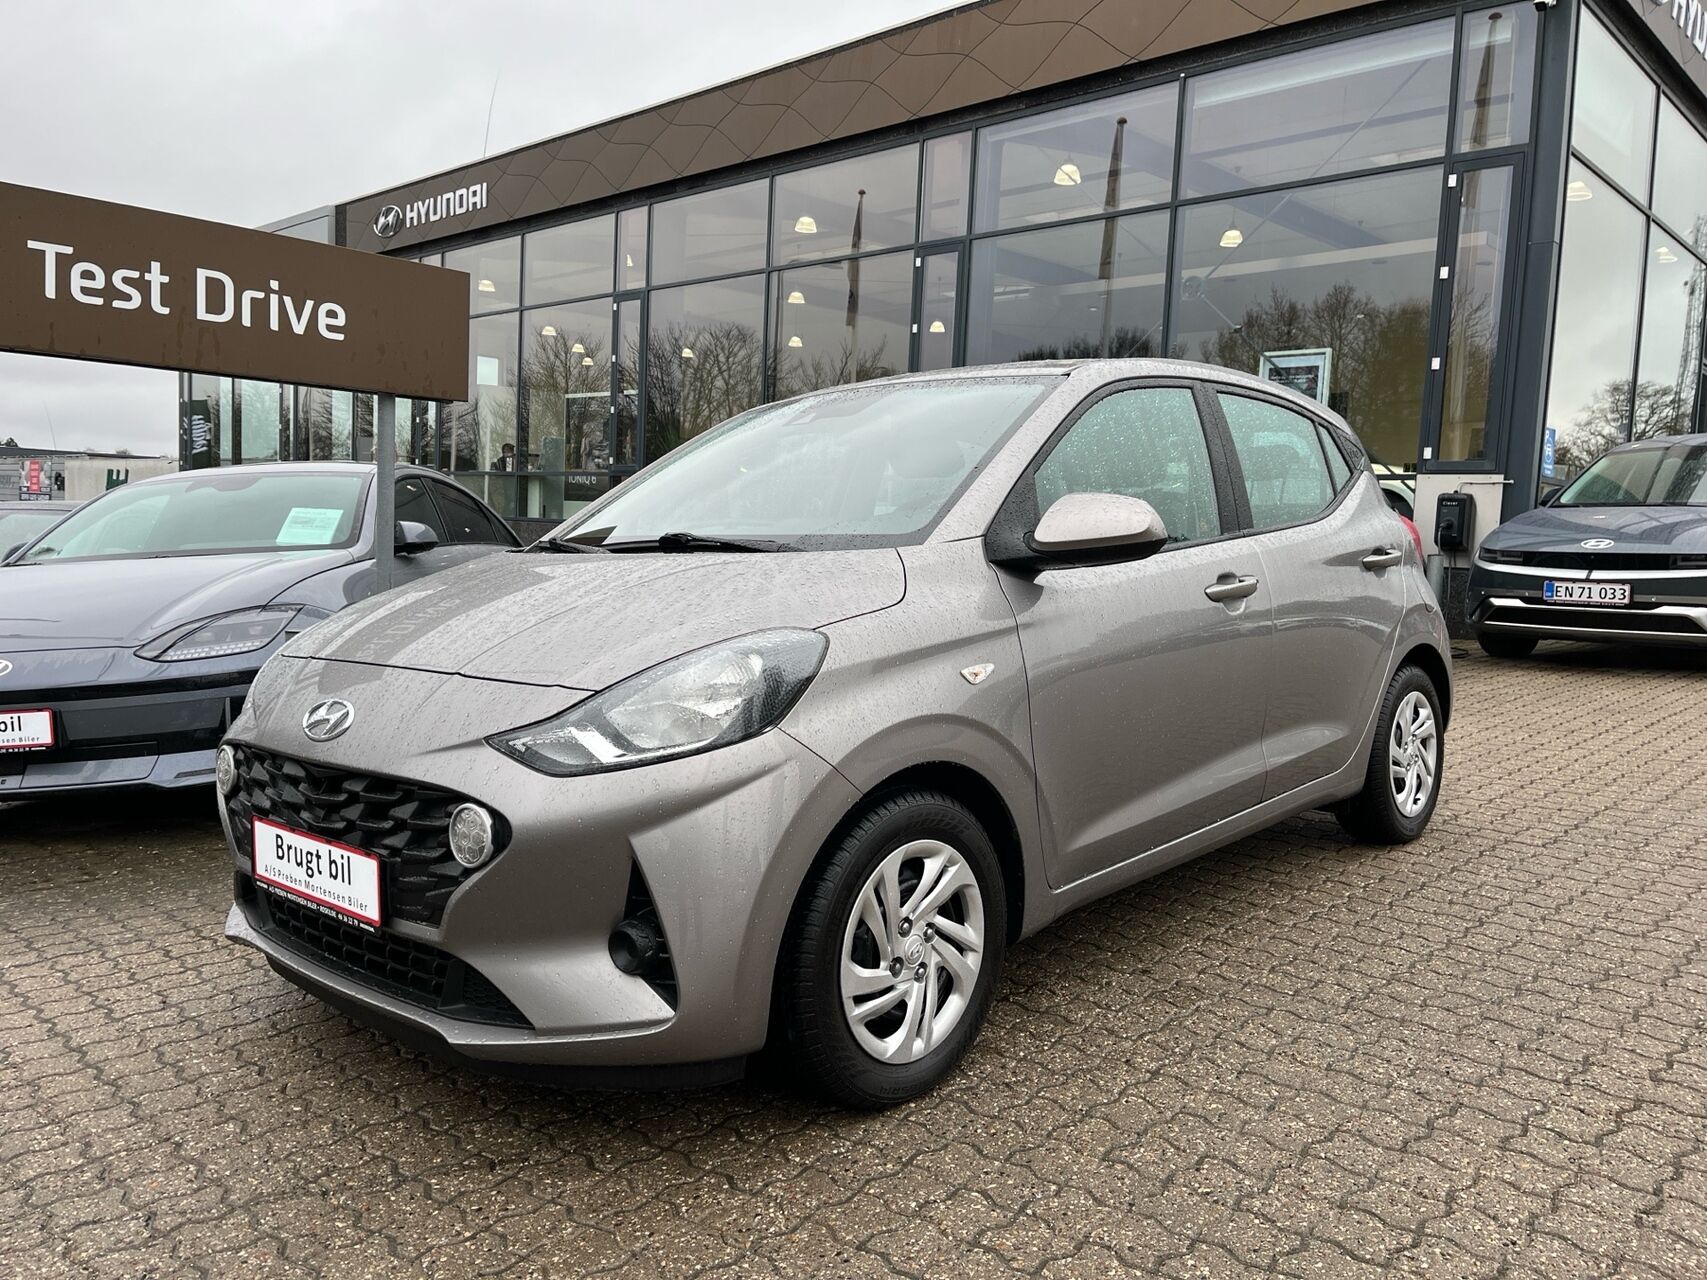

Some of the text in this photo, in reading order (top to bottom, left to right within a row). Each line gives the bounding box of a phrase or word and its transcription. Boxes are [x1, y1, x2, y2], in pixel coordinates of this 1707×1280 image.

[406, 182, 488, 228] HYUNDAI
[27, 239, 346, 341] Test Drive
[1555, 585, 1574, 598] EN
[1577, 586, 1593, 599] 71
[1599, 587, 1627, 601] 033
[275, 833, 352, 886] Brugt bil
[277, 869, 303, 888] Preben
[304, 879, 346, 904] Mortensen
[347, 896, 368, 912] Biler
